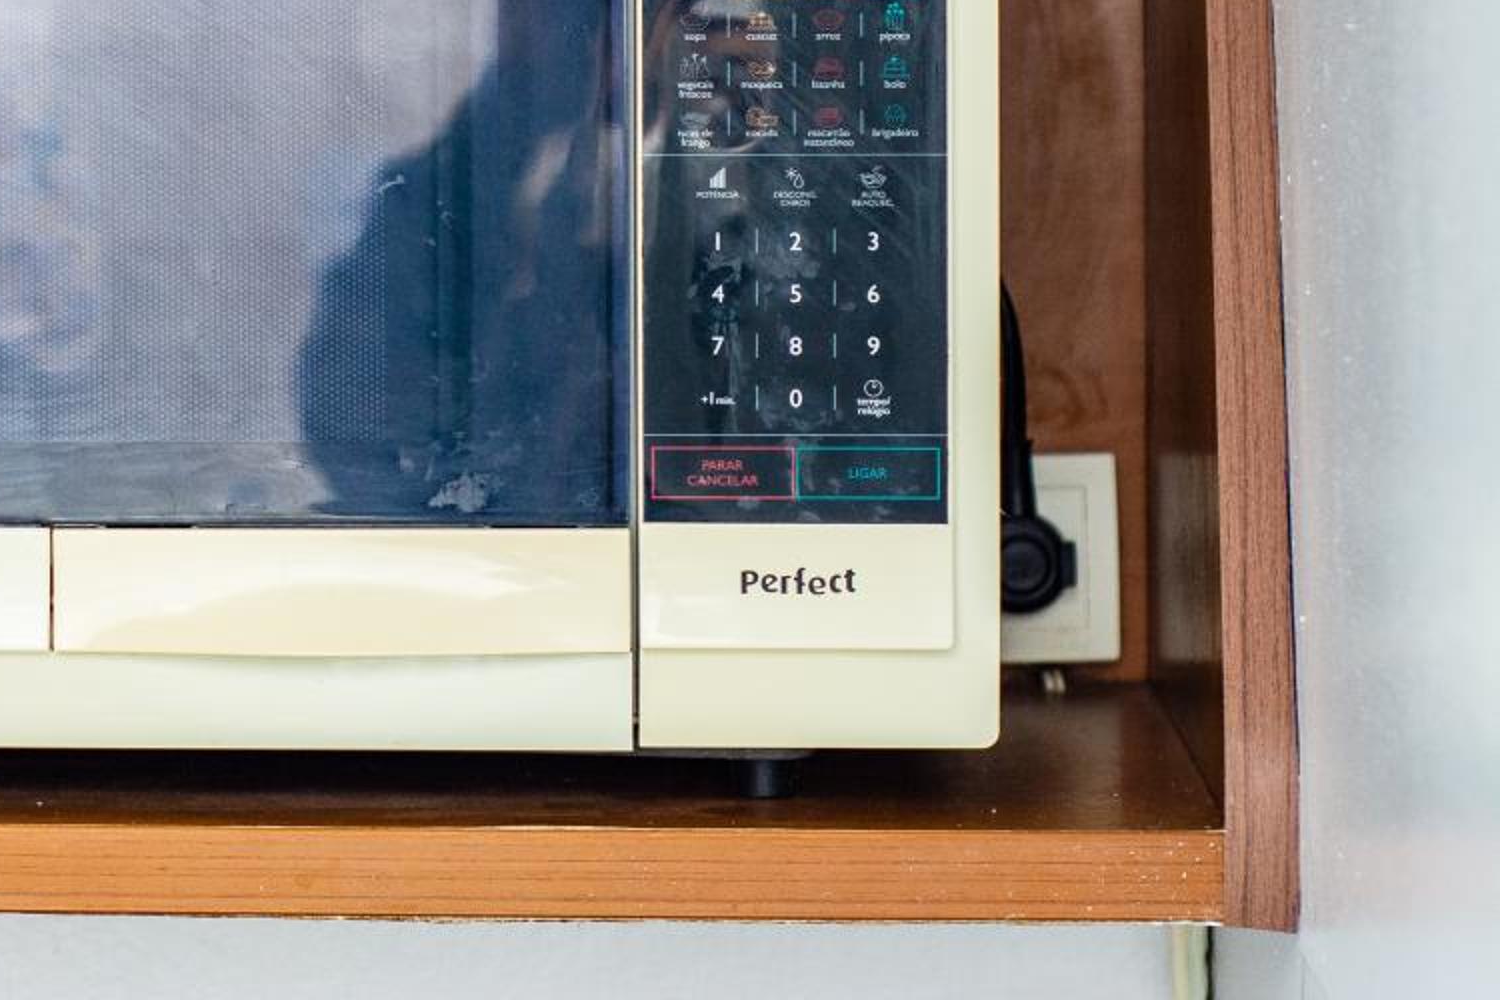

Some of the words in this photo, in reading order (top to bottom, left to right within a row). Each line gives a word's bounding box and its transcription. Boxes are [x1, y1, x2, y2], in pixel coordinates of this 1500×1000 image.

[883, 79, 907, 89] bolo
[714, 231, 722, 252] 1
[788, 231, 803, 252] 2
[866, 231, 880, 252] 3
[711, 284, 725, 304] 4
[789, 284, 802, 304] 5
[866, 284, 881, 304] 6
[711, 336, 725, 356] 7
[788, 335, 803, 356] 8
[866, 335, 881, 356] 9
[788, 388, 803, 409] 0
[700, 459, 744, 471] PARAR
[847, 467, 888, 480] LIGAR
[686, 474, 759, 487] CANCELAR
[740, 566, 857, 595] Perfect
